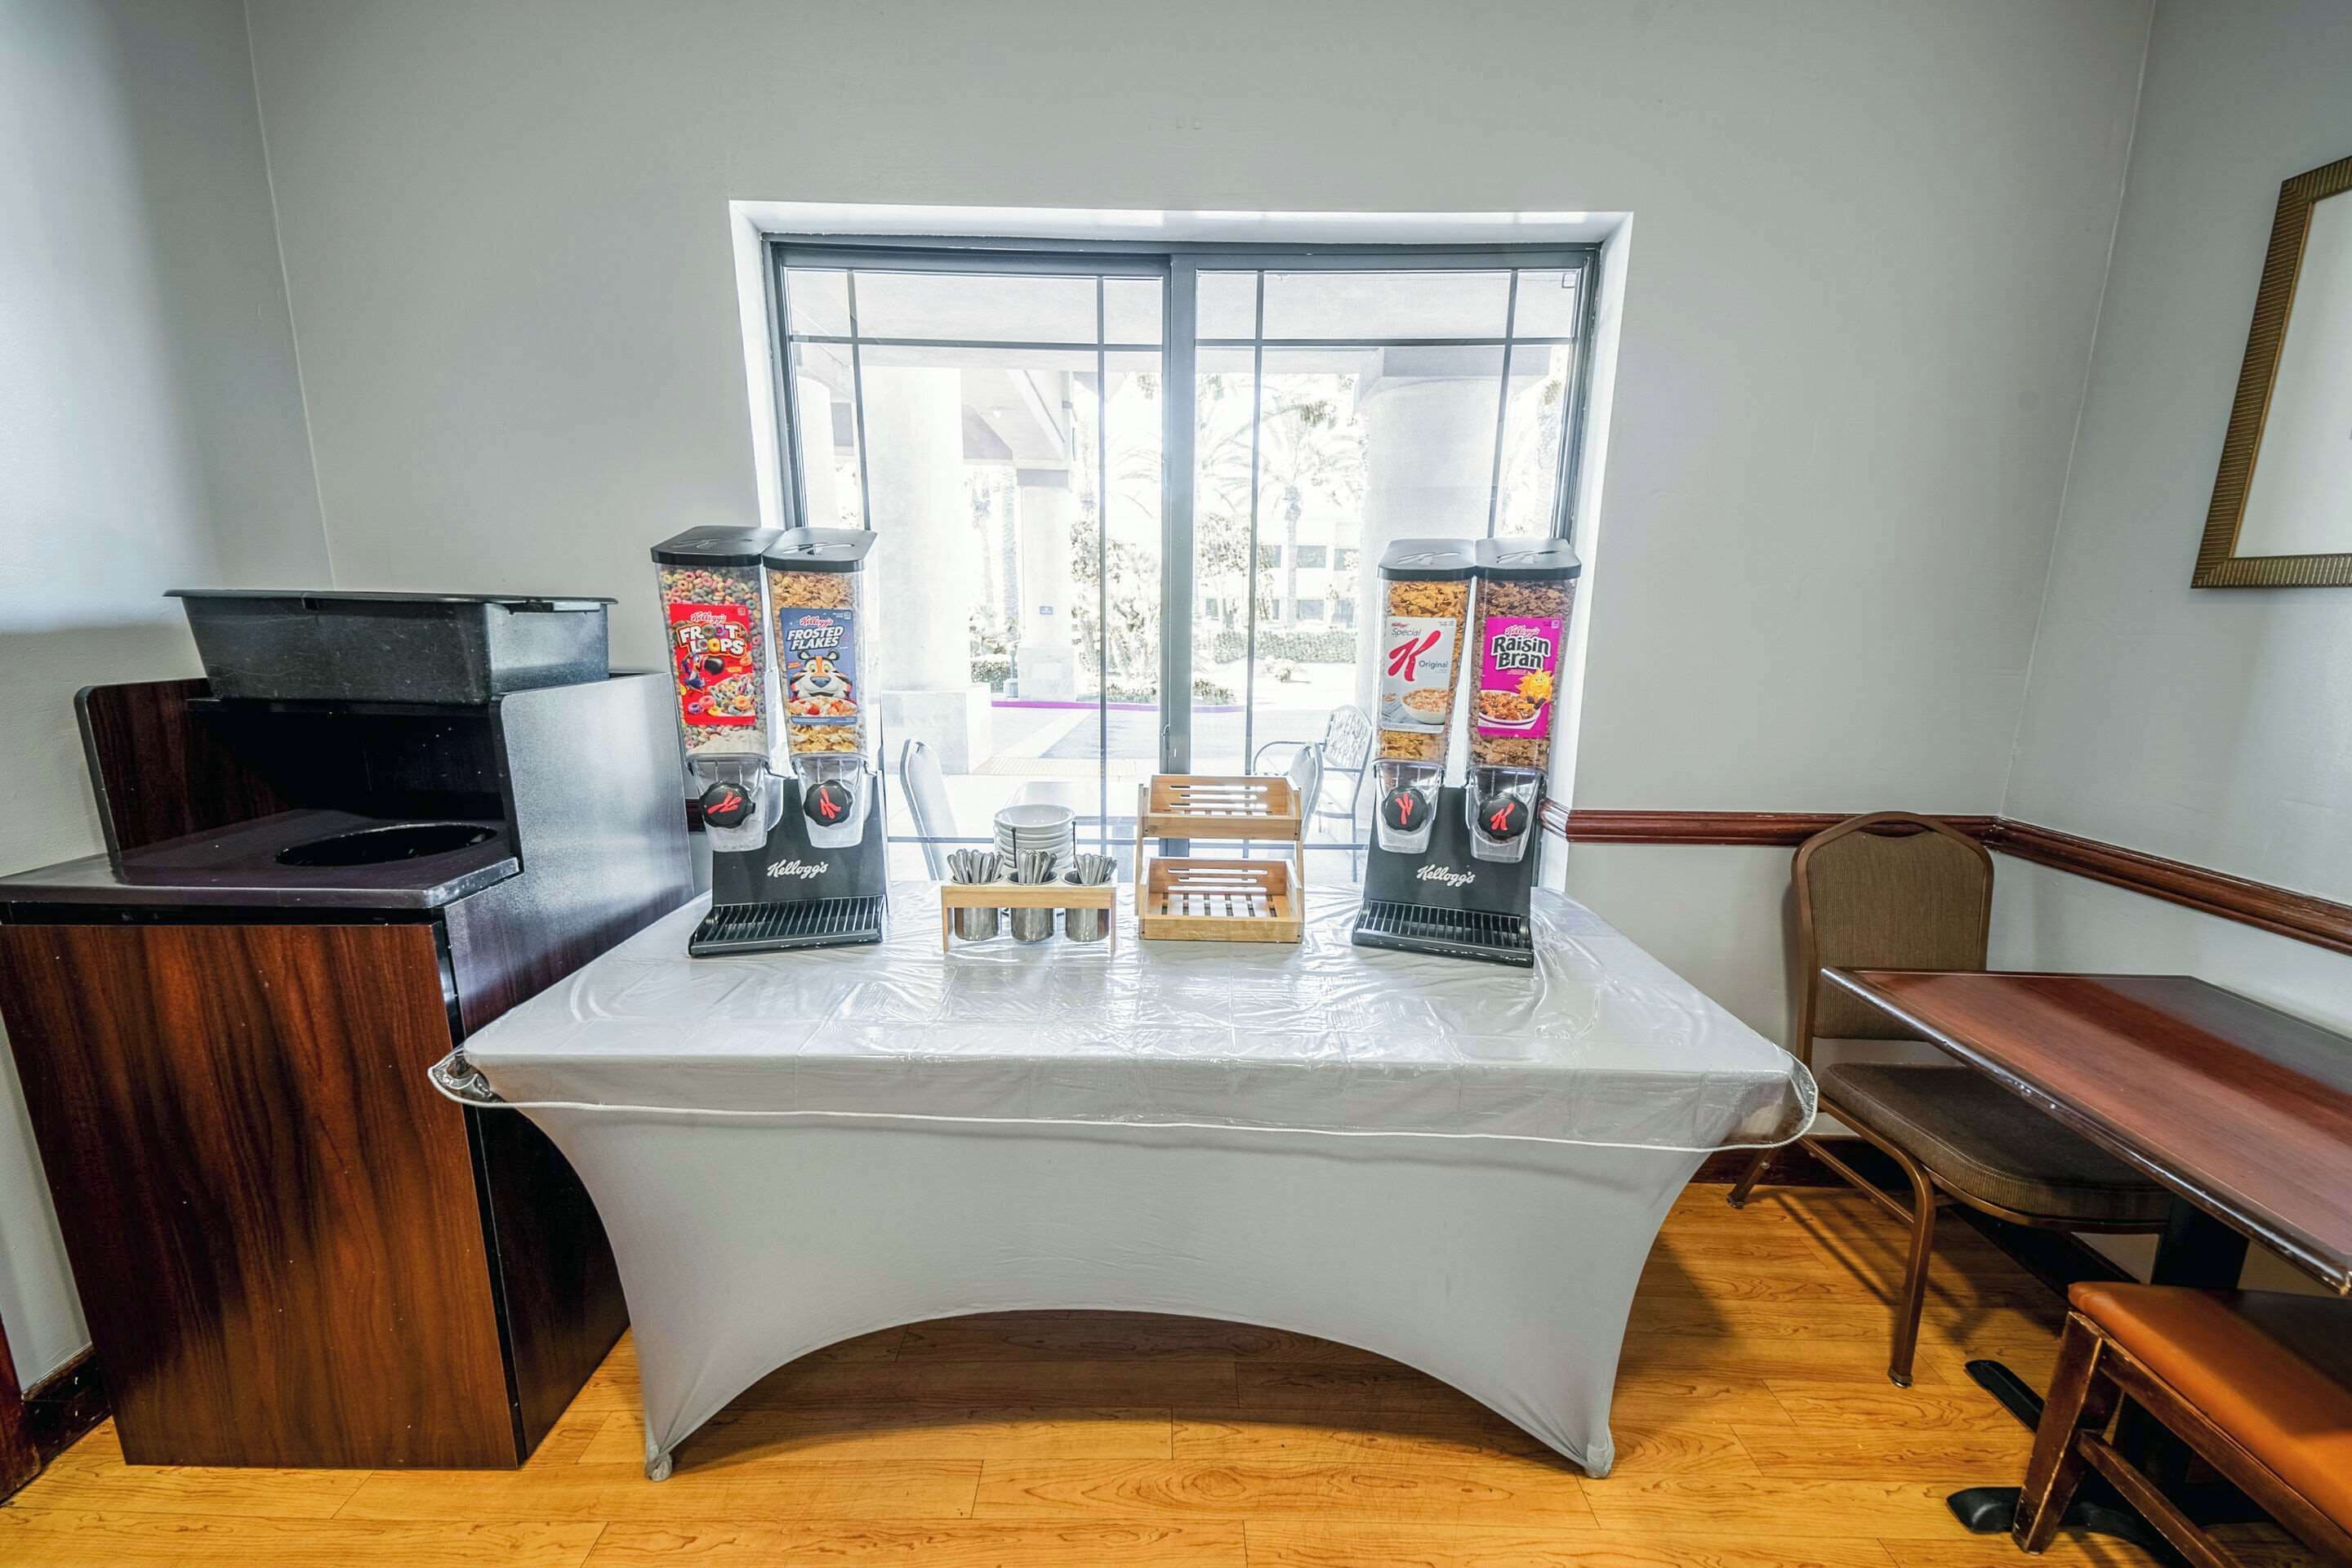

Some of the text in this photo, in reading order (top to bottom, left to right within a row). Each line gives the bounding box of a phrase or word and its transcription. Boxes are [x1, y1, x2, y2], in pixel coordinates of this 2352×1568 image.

[690, 611, 727, 624] Kellogg's
[800, 616, 834, 628] Kellogg's
[679, 624, 738, 644] FROOT
[787, 626, 844, 640] FROSTED
[1392, 627, 1421, 637] Special
[1504, 625, 1541, 639] Kellogg's
[690, 639, 744, 655] LOOPS
[791, 637, 839, 650] FLAKES
[1493, 636, 1549, 655] Raisin
[1388, 630, 1441, 681] K
[1498, 653, 1541, 668] Bran
[1419, 660, 1448, 670] Original
[1490, 802, 1515, 831] K
[767, 859, 828, 879] Kellogg's
[1416, 864, 1475, 887] Kellogg's
